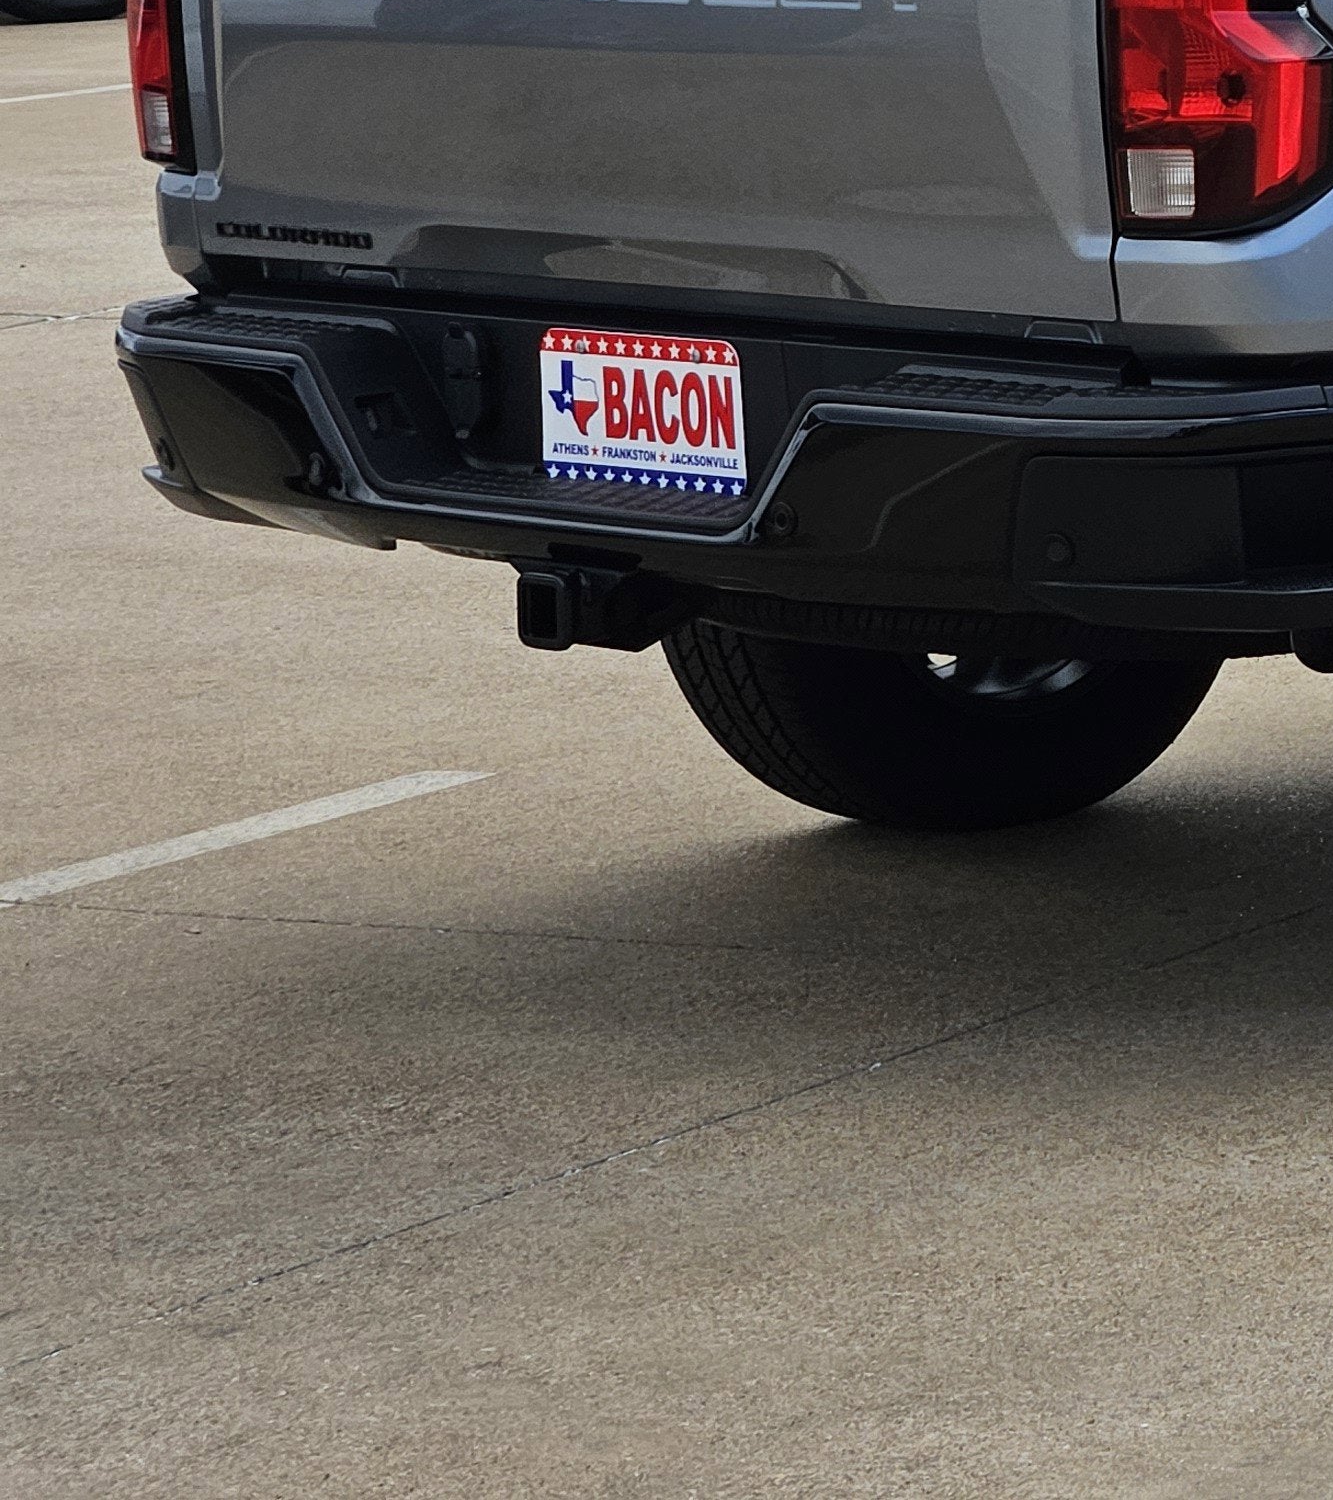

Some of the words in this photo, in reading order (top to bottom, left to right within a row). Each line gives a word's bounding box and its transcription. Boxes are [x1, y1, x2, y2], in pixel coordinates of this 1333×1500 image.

[603, 366, 736, 450] BACON
[552, 442, 590, 457] ATHENS
[601, 446, 657, 463] FRANKSTON
[669, 453, 740, 470] JACKSONVILLE
